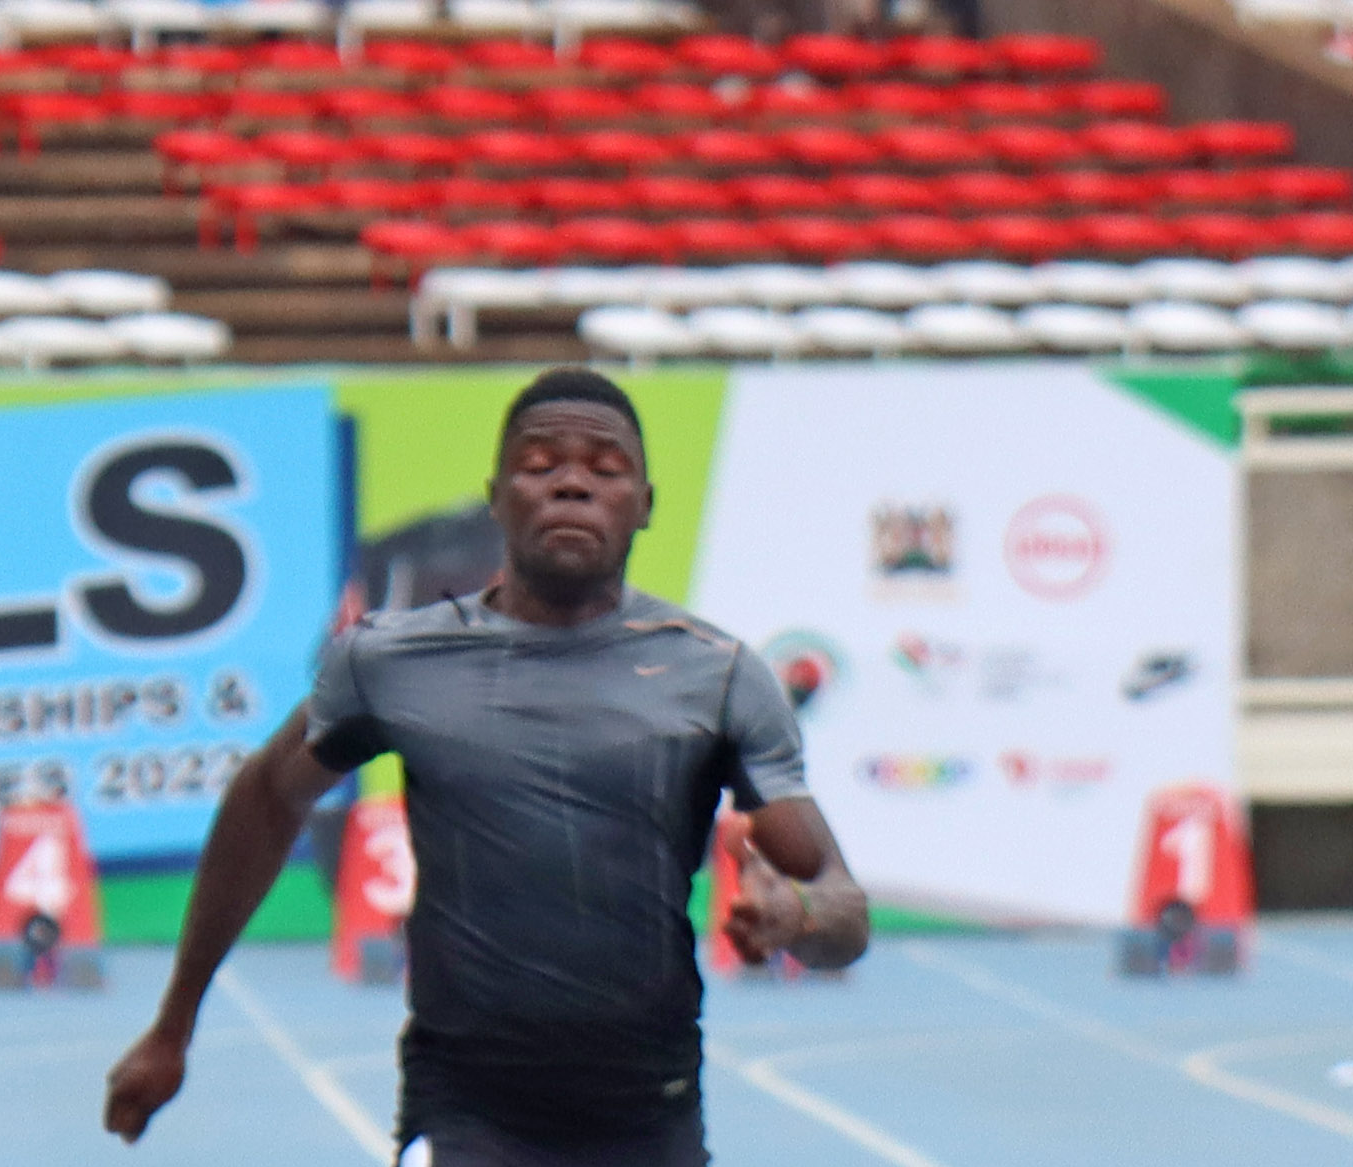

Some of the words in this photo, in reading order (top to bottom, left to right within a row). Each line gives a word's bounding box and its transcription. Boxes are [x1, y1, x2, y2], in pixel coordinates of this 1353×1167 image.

[210, 676, 250, 720] &
[3, 836, 70, 911] 4
[360, 829, 417, 914] 3
[1159, 815, 1215, 902] 1
